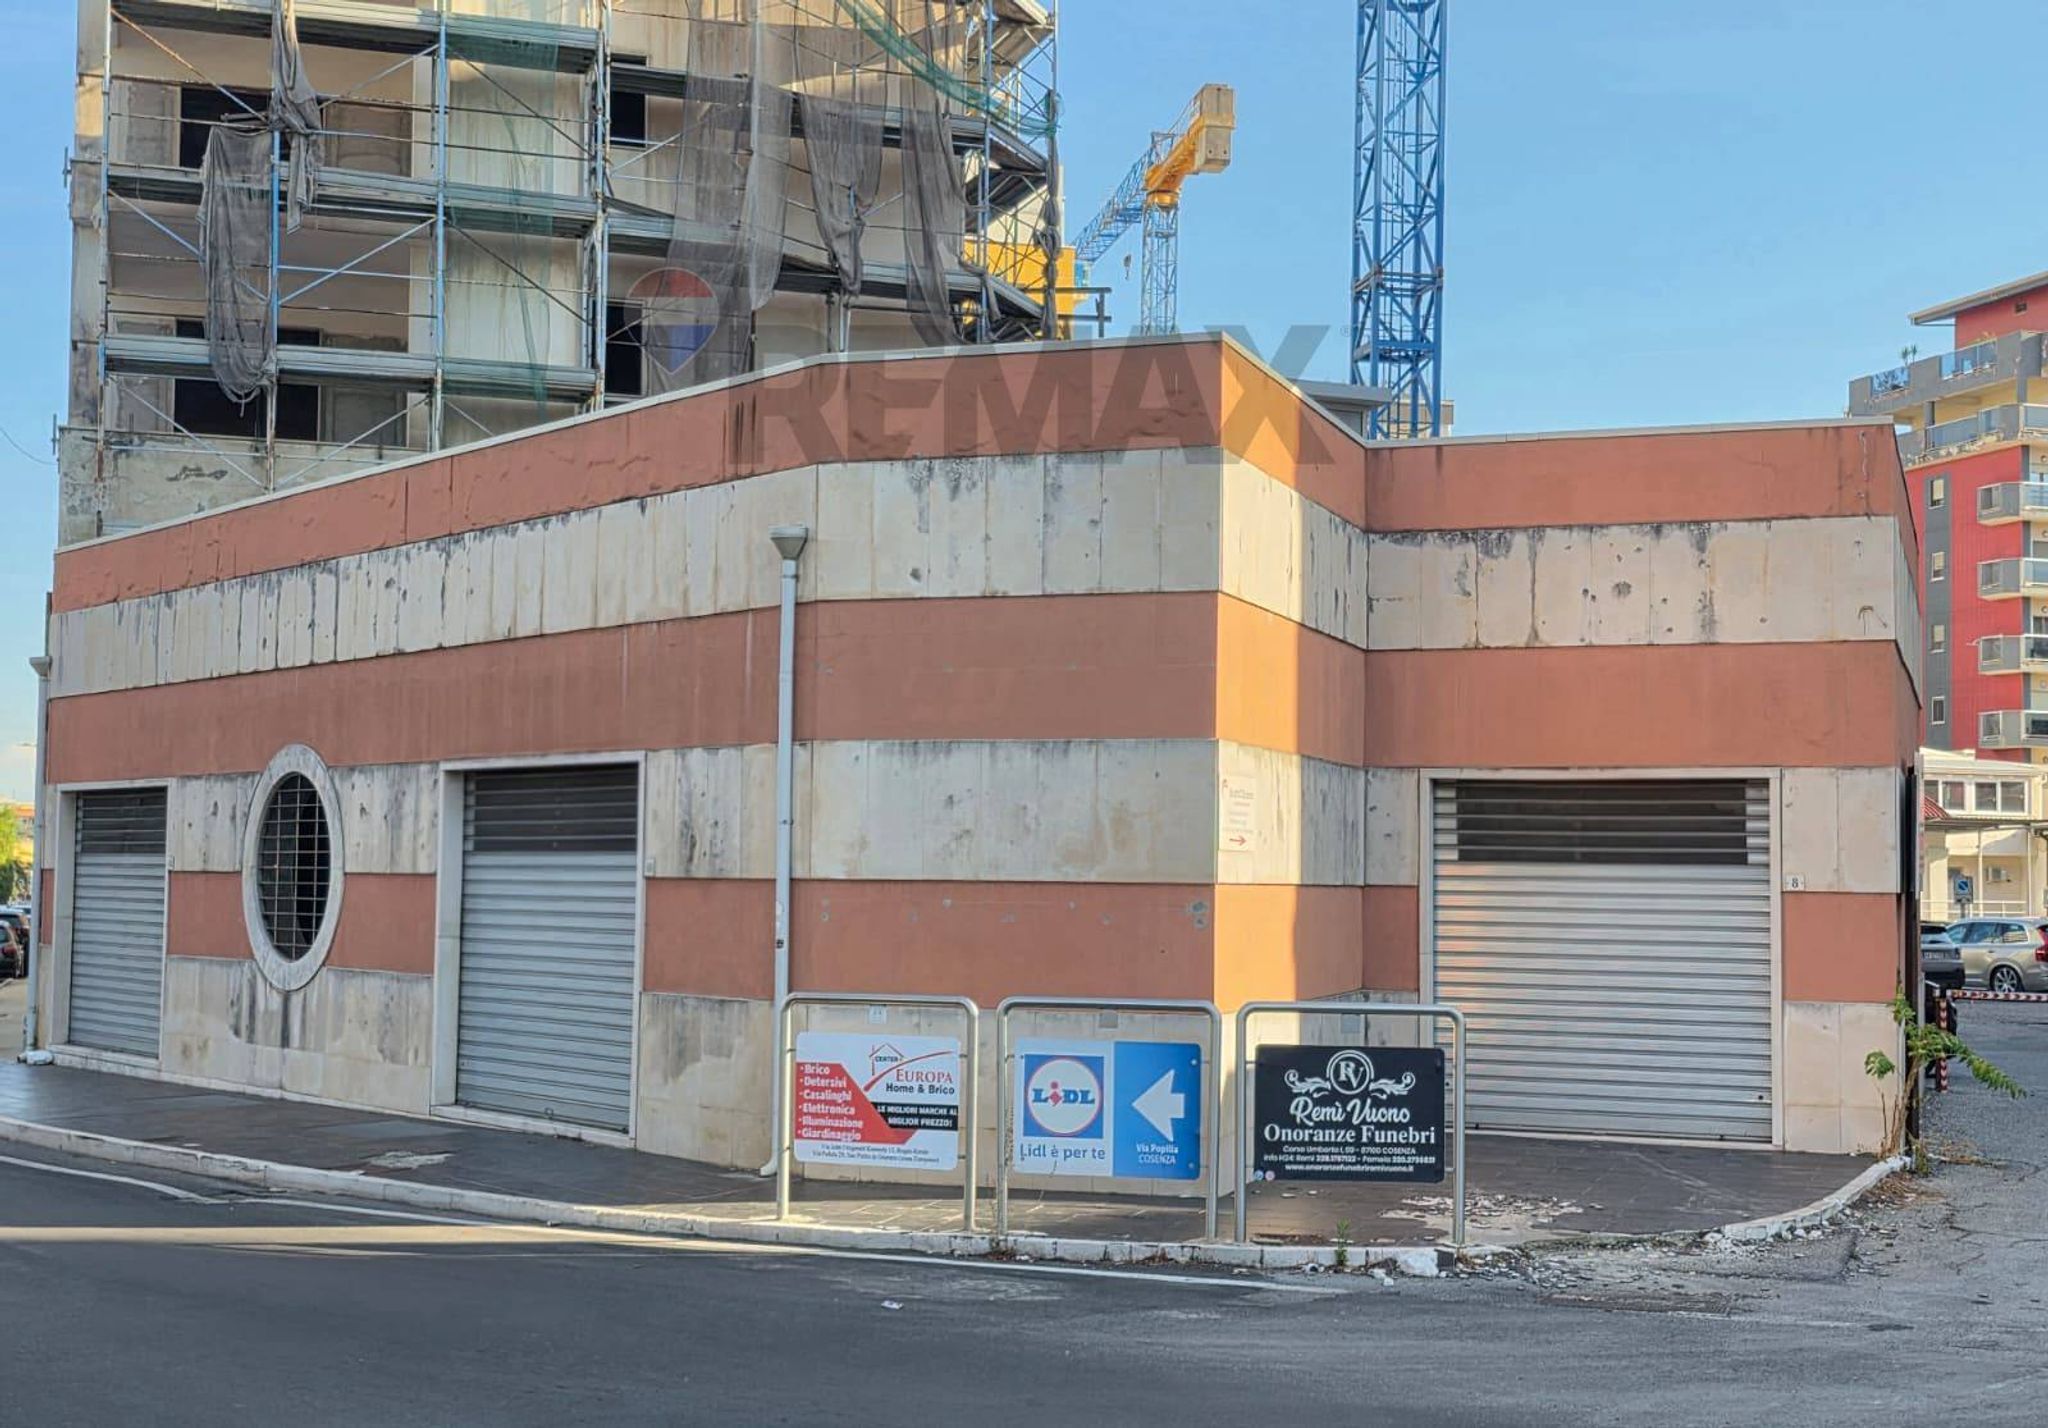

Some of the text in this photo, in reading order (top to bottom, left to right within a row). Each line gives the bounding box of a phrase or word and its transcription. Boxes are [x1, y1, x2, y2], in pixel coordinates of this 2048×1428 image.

[1792, 877, 1798, 888] 8
[804, 1063, 831, 1075] Brico
[804, 1076, 847, 1088] Detersivi
[896, 1069, 953, 1083] EUROPA
[886, 1083, 955, 1095] Home & Brico
[803, 1089, 852, 1103] Casalinghi
[803, 1103, 856, 1115] Elettronica
[887, 1106, 918, 1114] MIGLIORI
[919, 1107, 948, 1115] MARCHE
[1290, 1096, 1410, 1126] Remì Vuono
[802, 1116, 864, 1129] Illuminazione
[888, 1117, 952, 1128] MIGLIOR PREZZO!
[802, 1128, 862, 1142] Giardinaggio
[1264, 1124, 1435, 1144] Onoranze Funebri
[1020, 1144, 1106, 1162] Lidl è per te
[1136, 1144, 1149, 1152] Via
[1382, 1147, 1416, 1155] COSENZA
[1138, 1154, 1176, 1164] COSENZA
